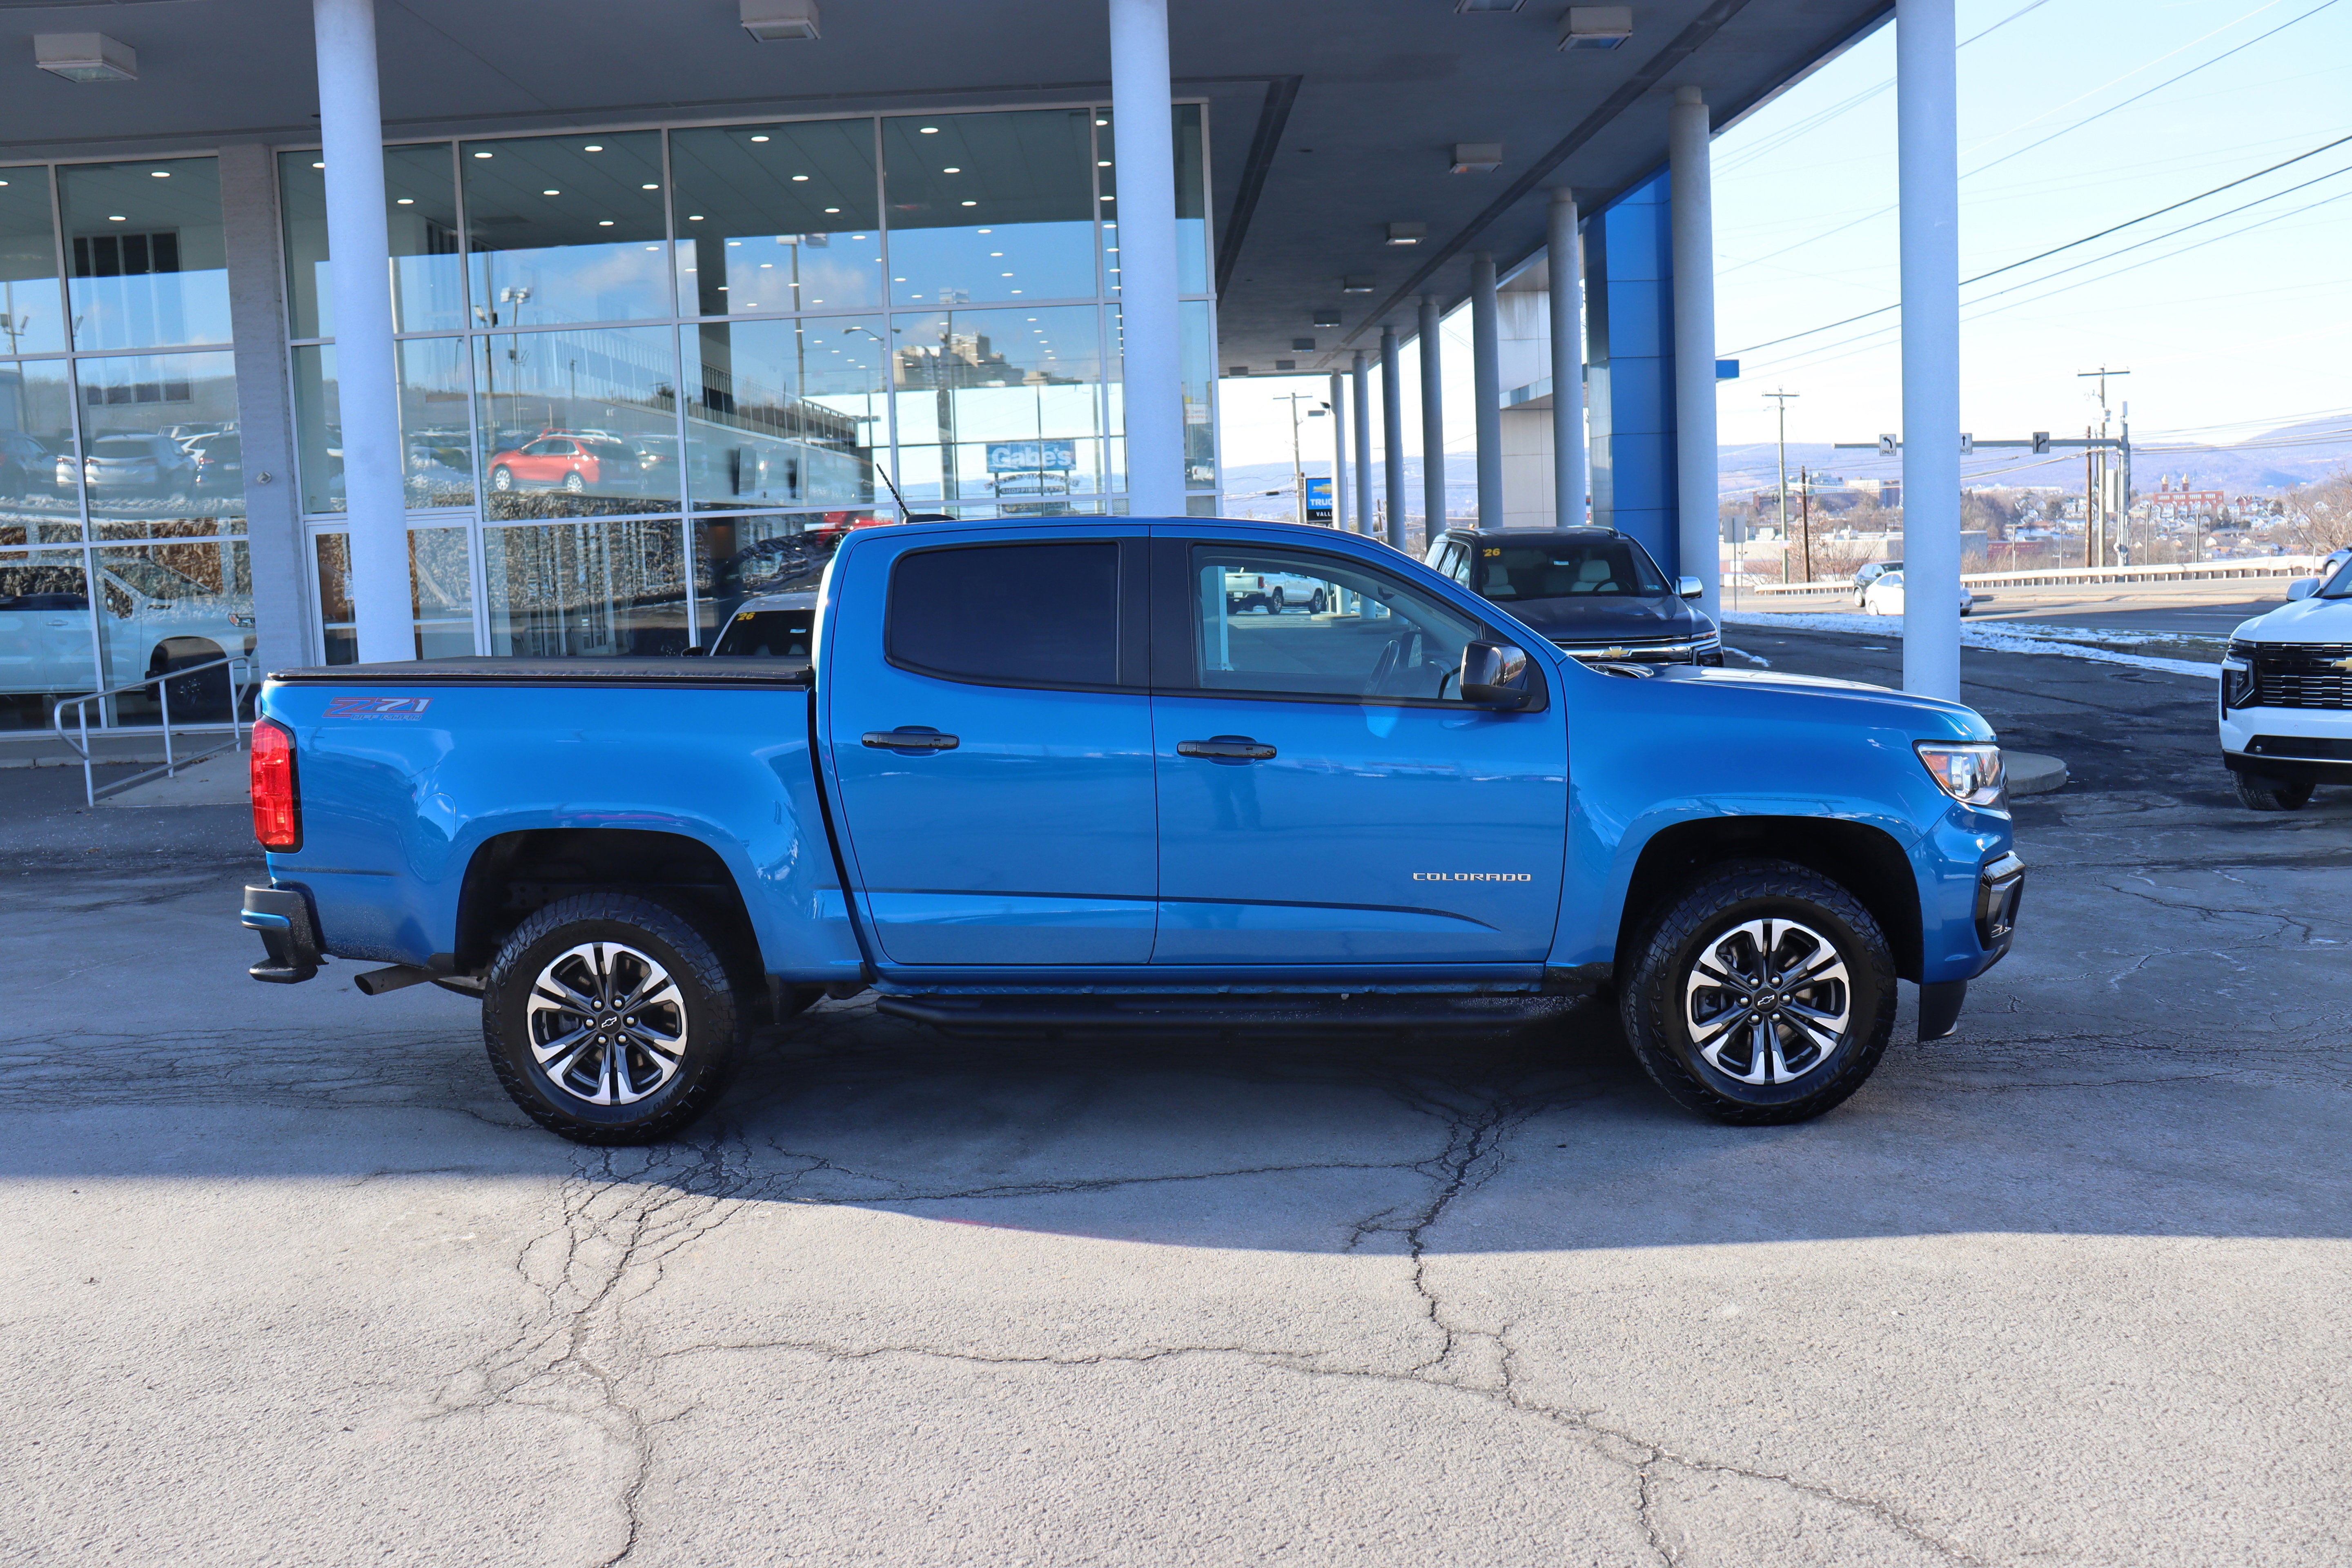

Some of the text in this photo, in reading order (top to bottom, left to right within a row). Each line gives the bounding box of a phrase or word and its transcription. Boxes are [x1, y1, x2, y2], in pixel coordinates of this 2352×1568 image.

[991, 447, 1072, 467] Gabe's
[1483, 548, 1501, 557] '26
[737, 612, 755, 621] '26
[322, 697, 434, 717] Z71
[1412, 873, 1531, 881] COLORADO
